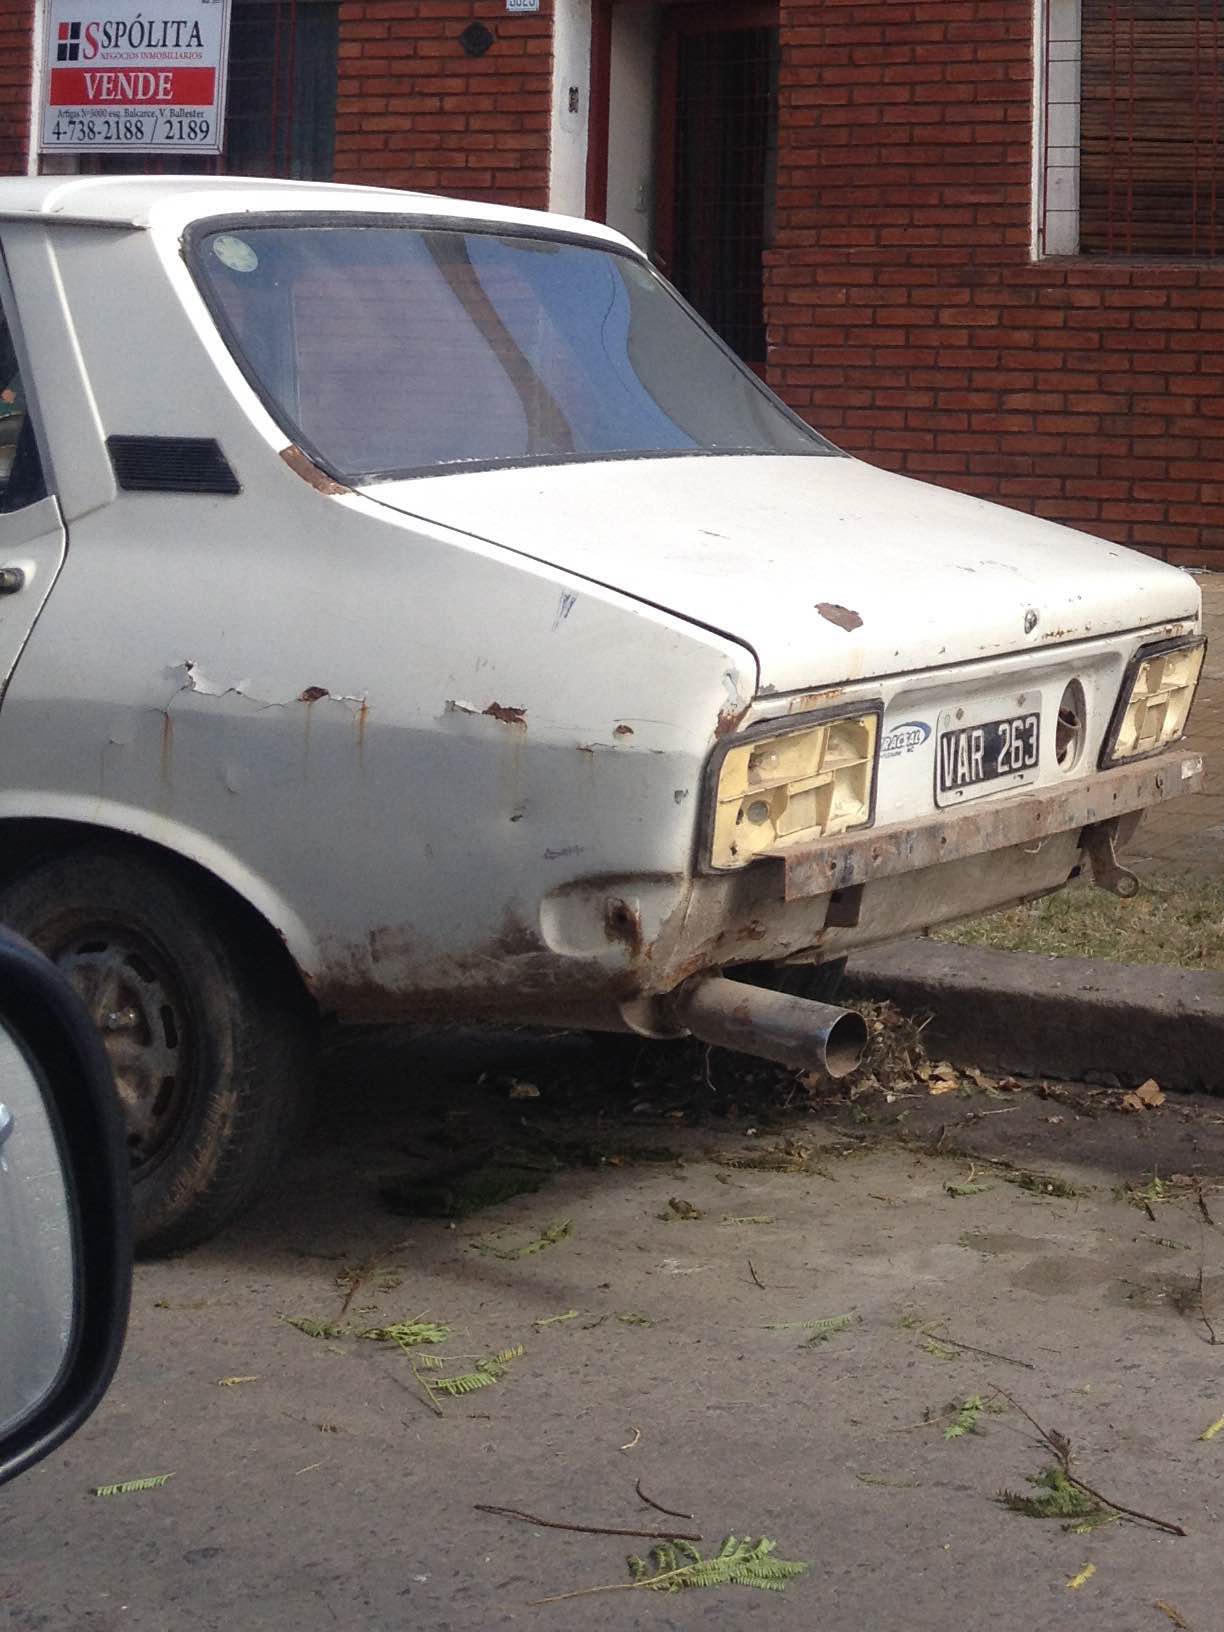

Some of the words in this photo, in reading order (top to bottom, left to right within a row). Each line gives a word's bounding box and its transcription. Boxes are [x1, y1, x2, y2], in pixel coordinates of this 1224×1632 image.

[83, 72, 173, 100] VENDE
[52, 119, 145, 142] 4-738-2188
[163, 119, 210, 142] 2189
[942, 729, 985, 787] VAR
[997, 716, 1038, 773] 263
